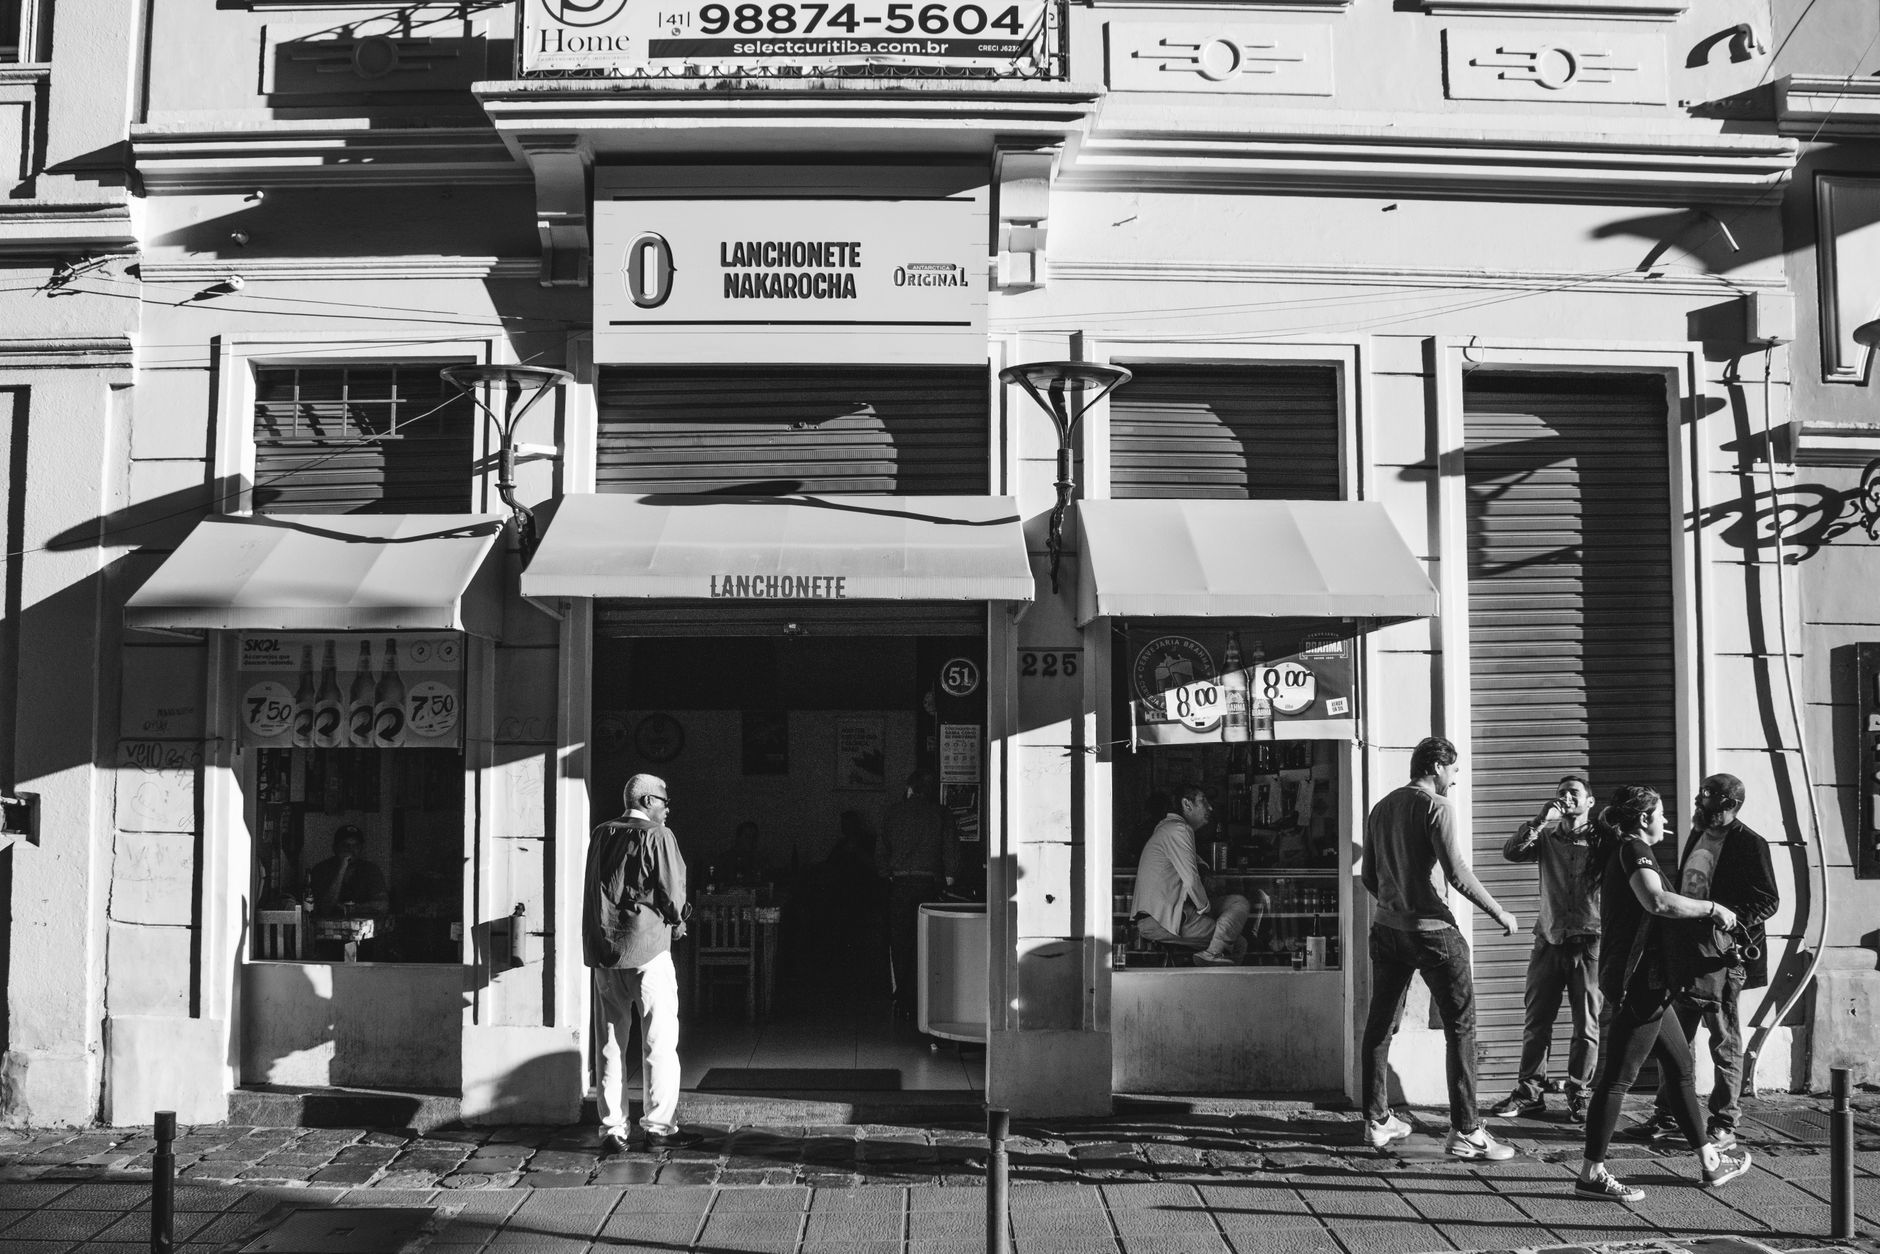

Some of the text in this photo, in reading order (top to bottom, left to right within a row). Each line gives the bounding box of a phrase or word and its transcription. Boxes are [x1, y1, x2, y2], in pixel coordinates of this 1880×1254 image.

[699, 3, 1024, 35] 98874-5604
[540, 29, 630, 53] Home
[733, 40, 949, 54] selectcuritiba.com.br
[978, 44, 999, 52] CRECI
[720, 241, 862, 268] LANCHONETE
[723, 272, 857, 299] NAKAROCHA
[710, 575, 846, 598] LANCHONETE
[244, 639, 280, 652] SKOL
[1137, 639, 1211, 673] CERVEJARIA BRAHMA
[1305, 641, 1343, 653] BRAHMA
[949, 667, 971, 686] 51
[1021, 653, 1077, 677] 225
